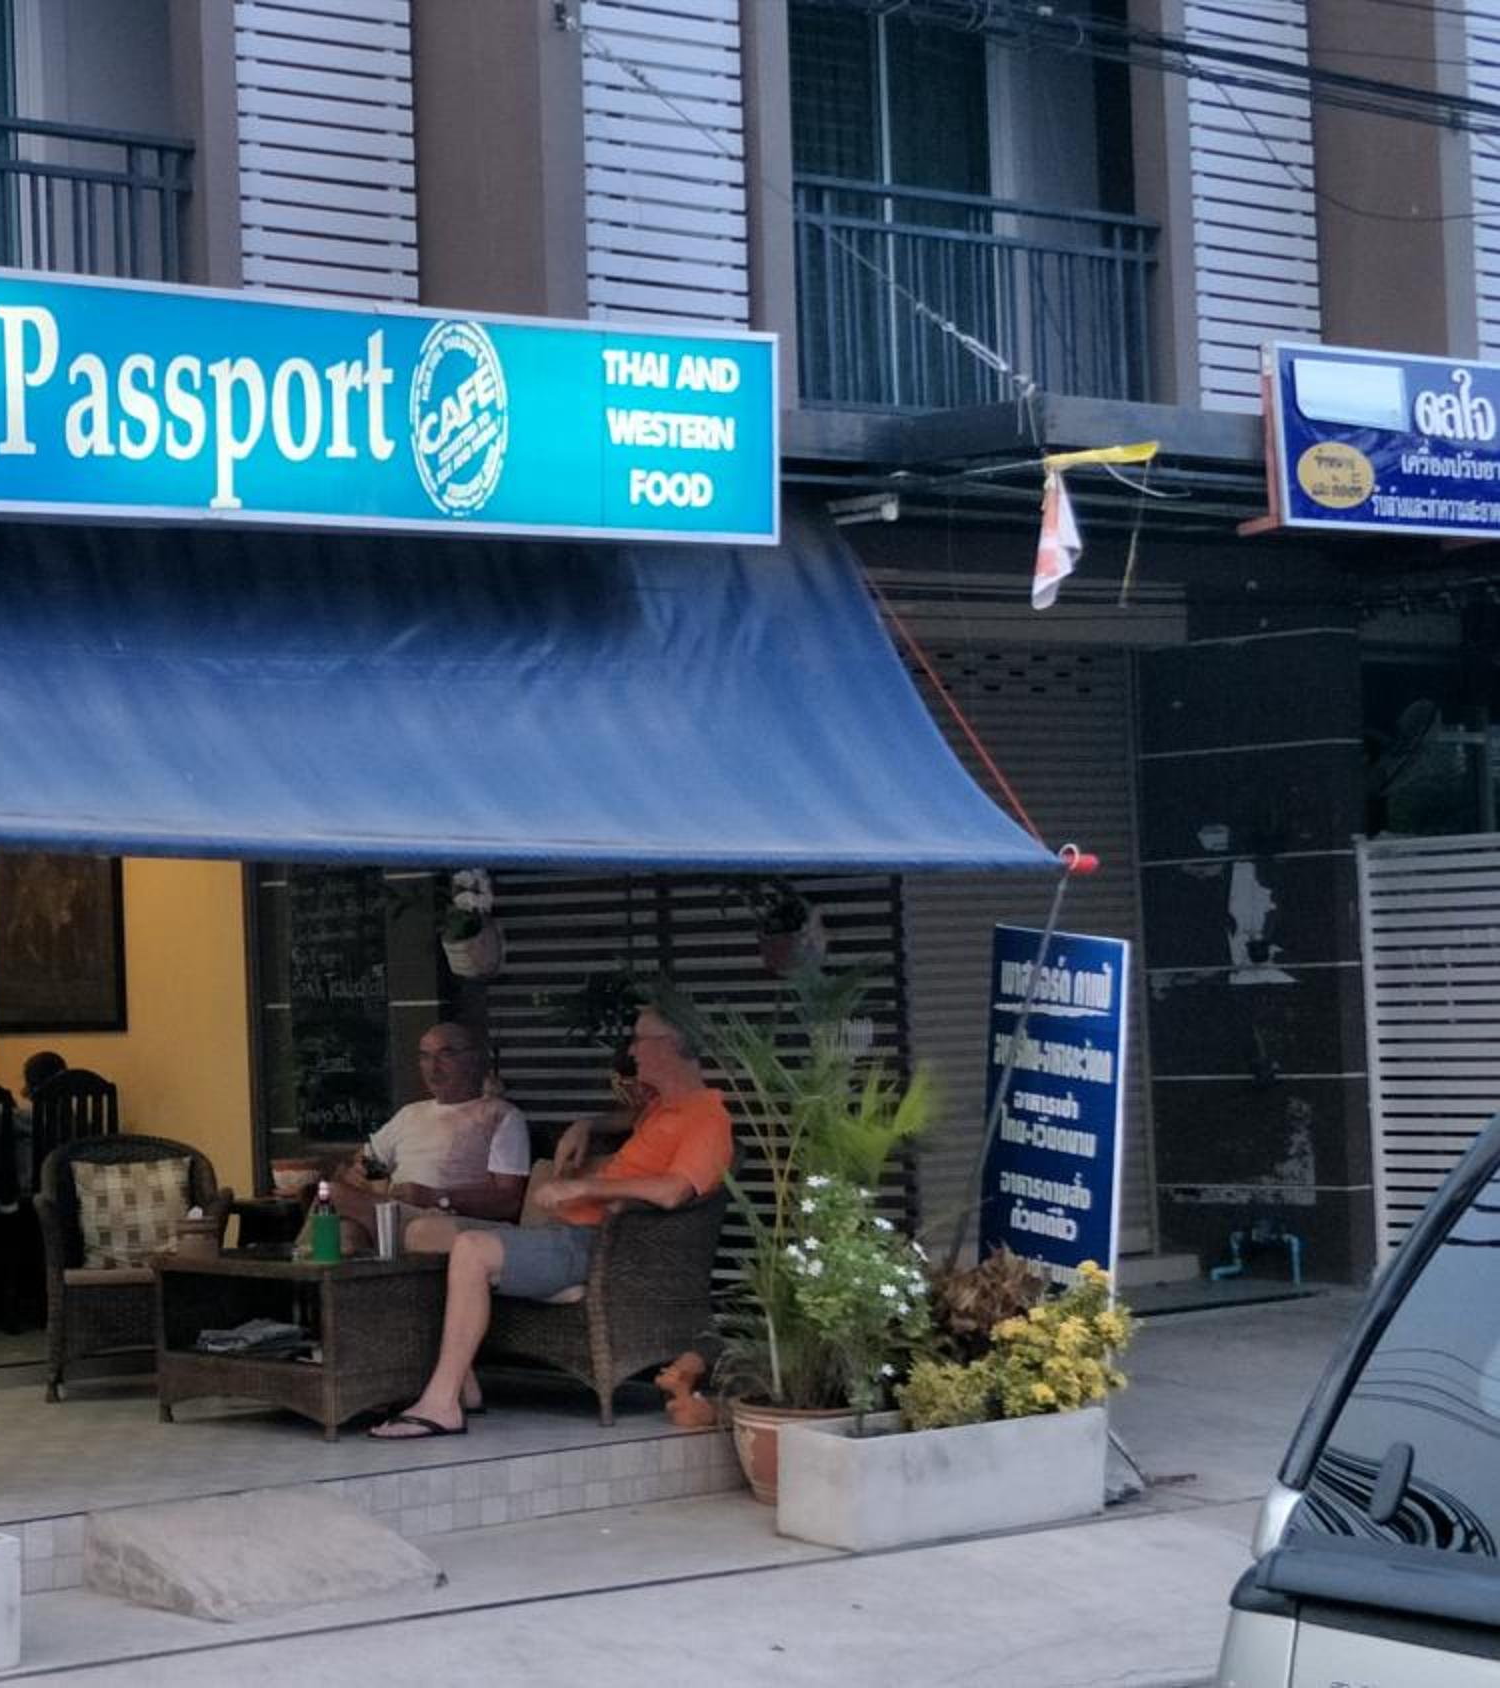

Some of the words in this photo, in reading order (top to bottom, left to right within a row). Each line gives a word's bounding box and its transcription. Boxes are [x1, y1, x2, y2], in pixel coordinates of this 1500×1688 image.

[603, 349, 669, 388] THAI
[675, 354, 741, 393] AND
[418, 363, 498, 455] CAFE
[606, 408, 736, 451] WESTERN
[630, 469, 714, 507] FOOD
